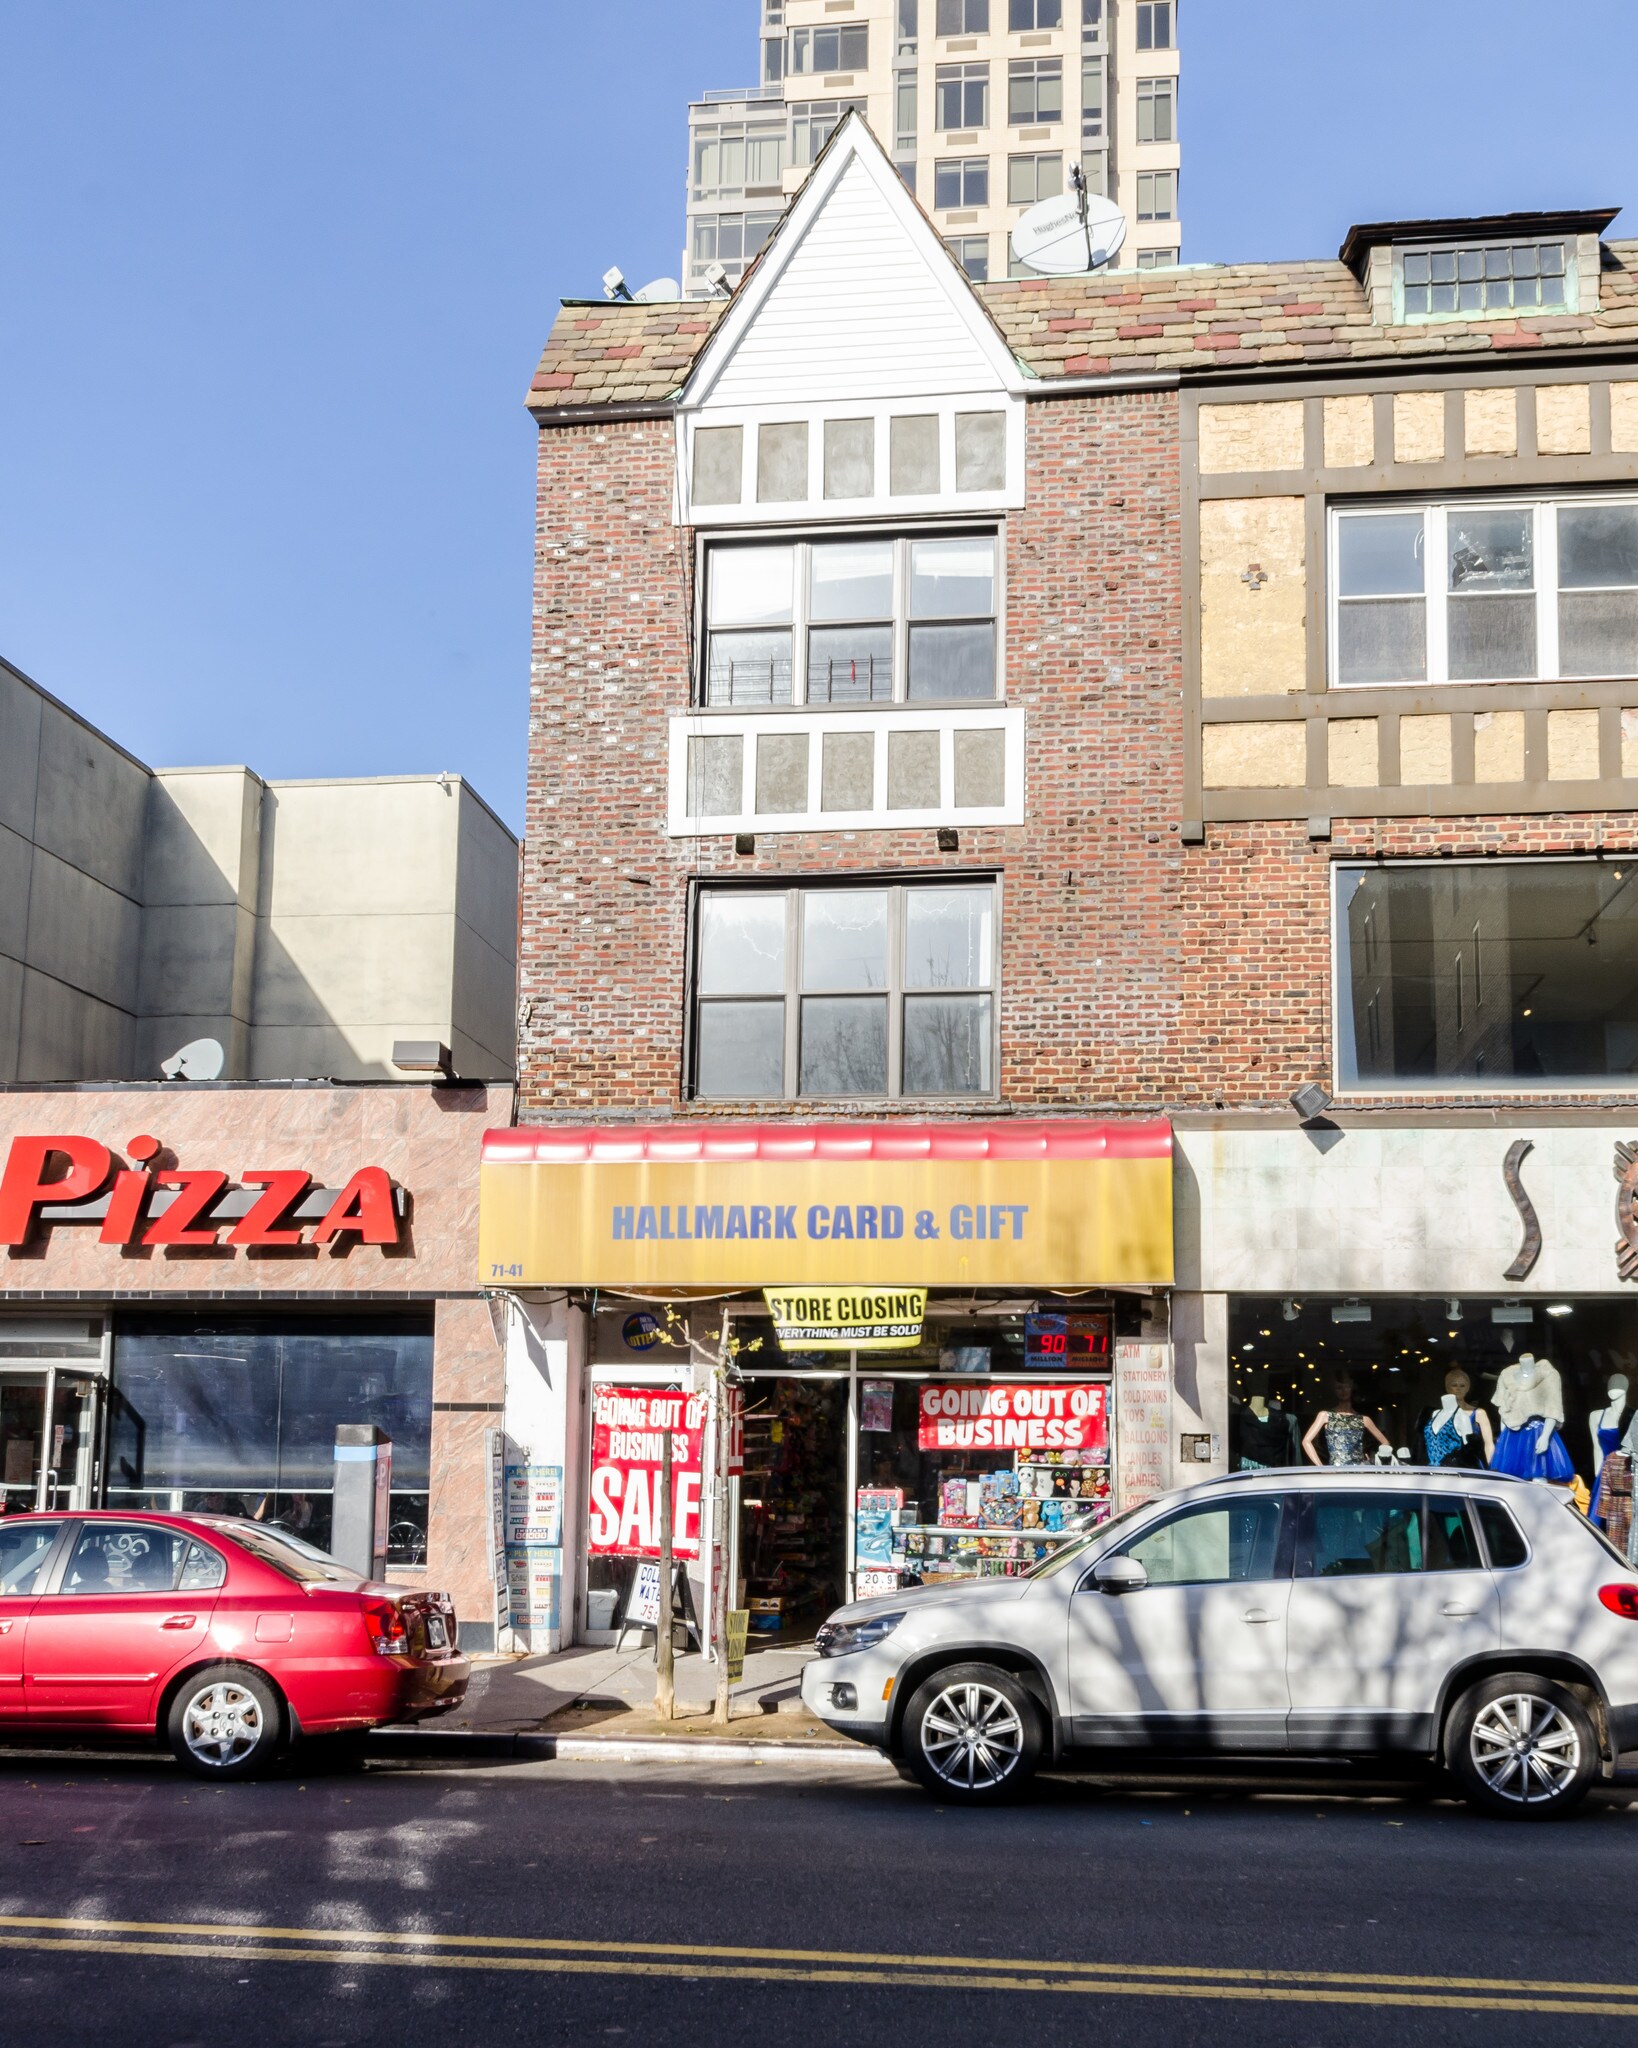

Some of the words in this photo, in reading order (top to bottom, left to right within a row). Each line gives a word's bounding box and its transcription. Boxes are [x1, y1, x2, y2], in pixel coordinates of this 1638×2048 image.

[612, 1205, 798, 1240] HALLMARK
[807, 1204, 904, 1240] CARD
[915, 1208, 940, 1240] &
[949, 1205, 1029, 1240] GIFT
[491, 1263, 523, 1277] 71-41
[771, 1297, 832, 1322] STORE
[837, 1294, 922, 1321] CLOSING
[841, 1326, 872, 1338] MUST
[873, 1326, 888, 1337] BE
[890, 1324, 922, 1337] SOLD!
[1041, 1334, 1066, 1354] 90
[1084, 1335, 1107, 1353] 71
[1123, 1345, 1140, 1359] ATM
[1123, 1370, 1167, 1382] STATIONERY
[922, 1388, 1009, 1416] GOING
[1013, 1389, 1066, 1416] OUT
[1071, 1390, 1102, 1416] OF
[1123, 1390, 1141, 1403] COLD
[1143, 1390, 1167, 1404] DRINKS
[596, 1396, 647, 1427] GOING
[650, 1399, 682, 1429] OUT
[1124, 1409, 1145, 1423] TOYS
[937, 1419, 1084, 1447] BUSINESS
[1125, 1431, 1168, 1445] BALLOONS
[1125, 1452, 1162, 1466] CANDLES
[516, 1468, 534, 1476] PLAY
[537, 1468, 557, 1476] HERE!
[1125, 1473, 1160, 1488] CANDIES
[590, 1467, 701, 1549] SALE
[865, 1573, 893, 1584] 209
[639, 1583, 660, 1602] WATE
